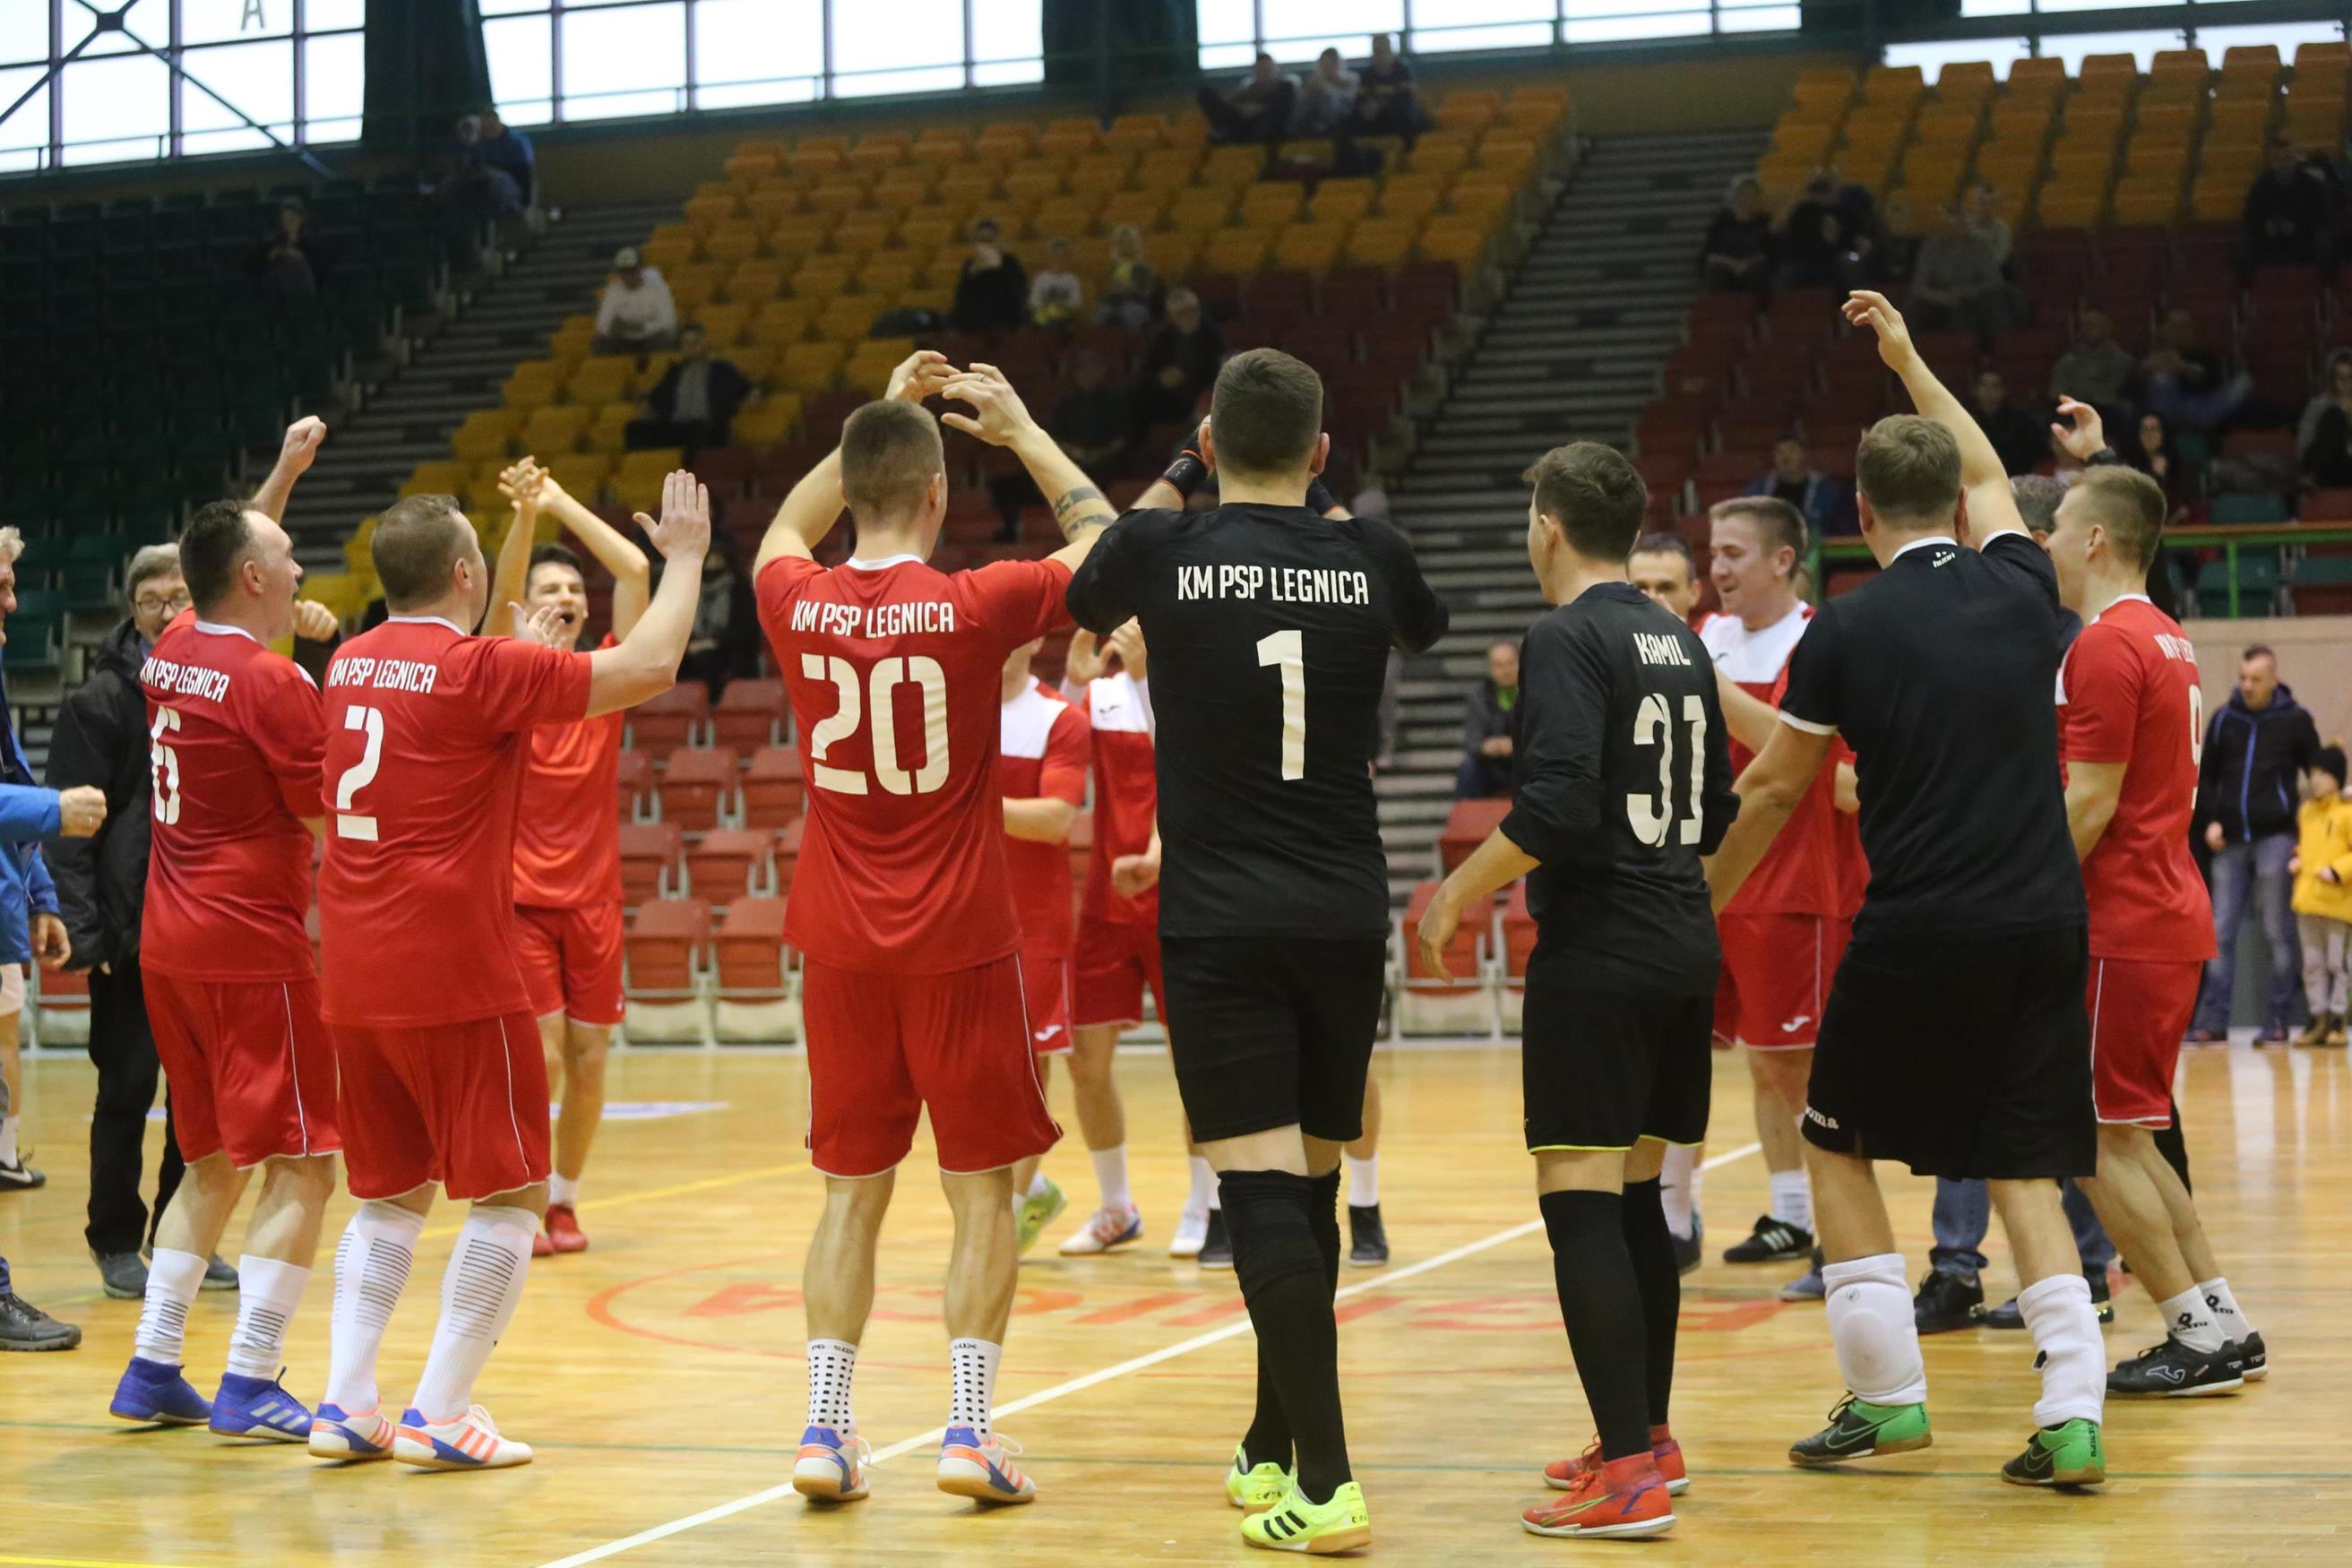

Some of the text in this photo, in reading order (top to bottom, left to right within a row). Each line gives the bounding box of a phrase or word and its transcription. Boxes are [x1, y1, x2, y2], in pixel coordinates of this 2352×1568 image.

[1178, 564, 1369, 605] KM PSP LEGNICA
[791, 600, 954, 639] KM PSP LEGNICA
[1633, 633, 1692, 667] KAMIL
[154, 659, 179, 692] PSP
[175, 665, 230, 703] LEGNICA
[328, 657, 437, 694] KM PSP LEGNICA
[801, 654, 950, 795] 20
[1256, 630, 1305, 780] 1
[150, 705, 181, 825] 6
[336, 704, 384, 841] 2
[1626, 693, 1707, 848] 31
[1805, 1106, 1839, 1130] oma
